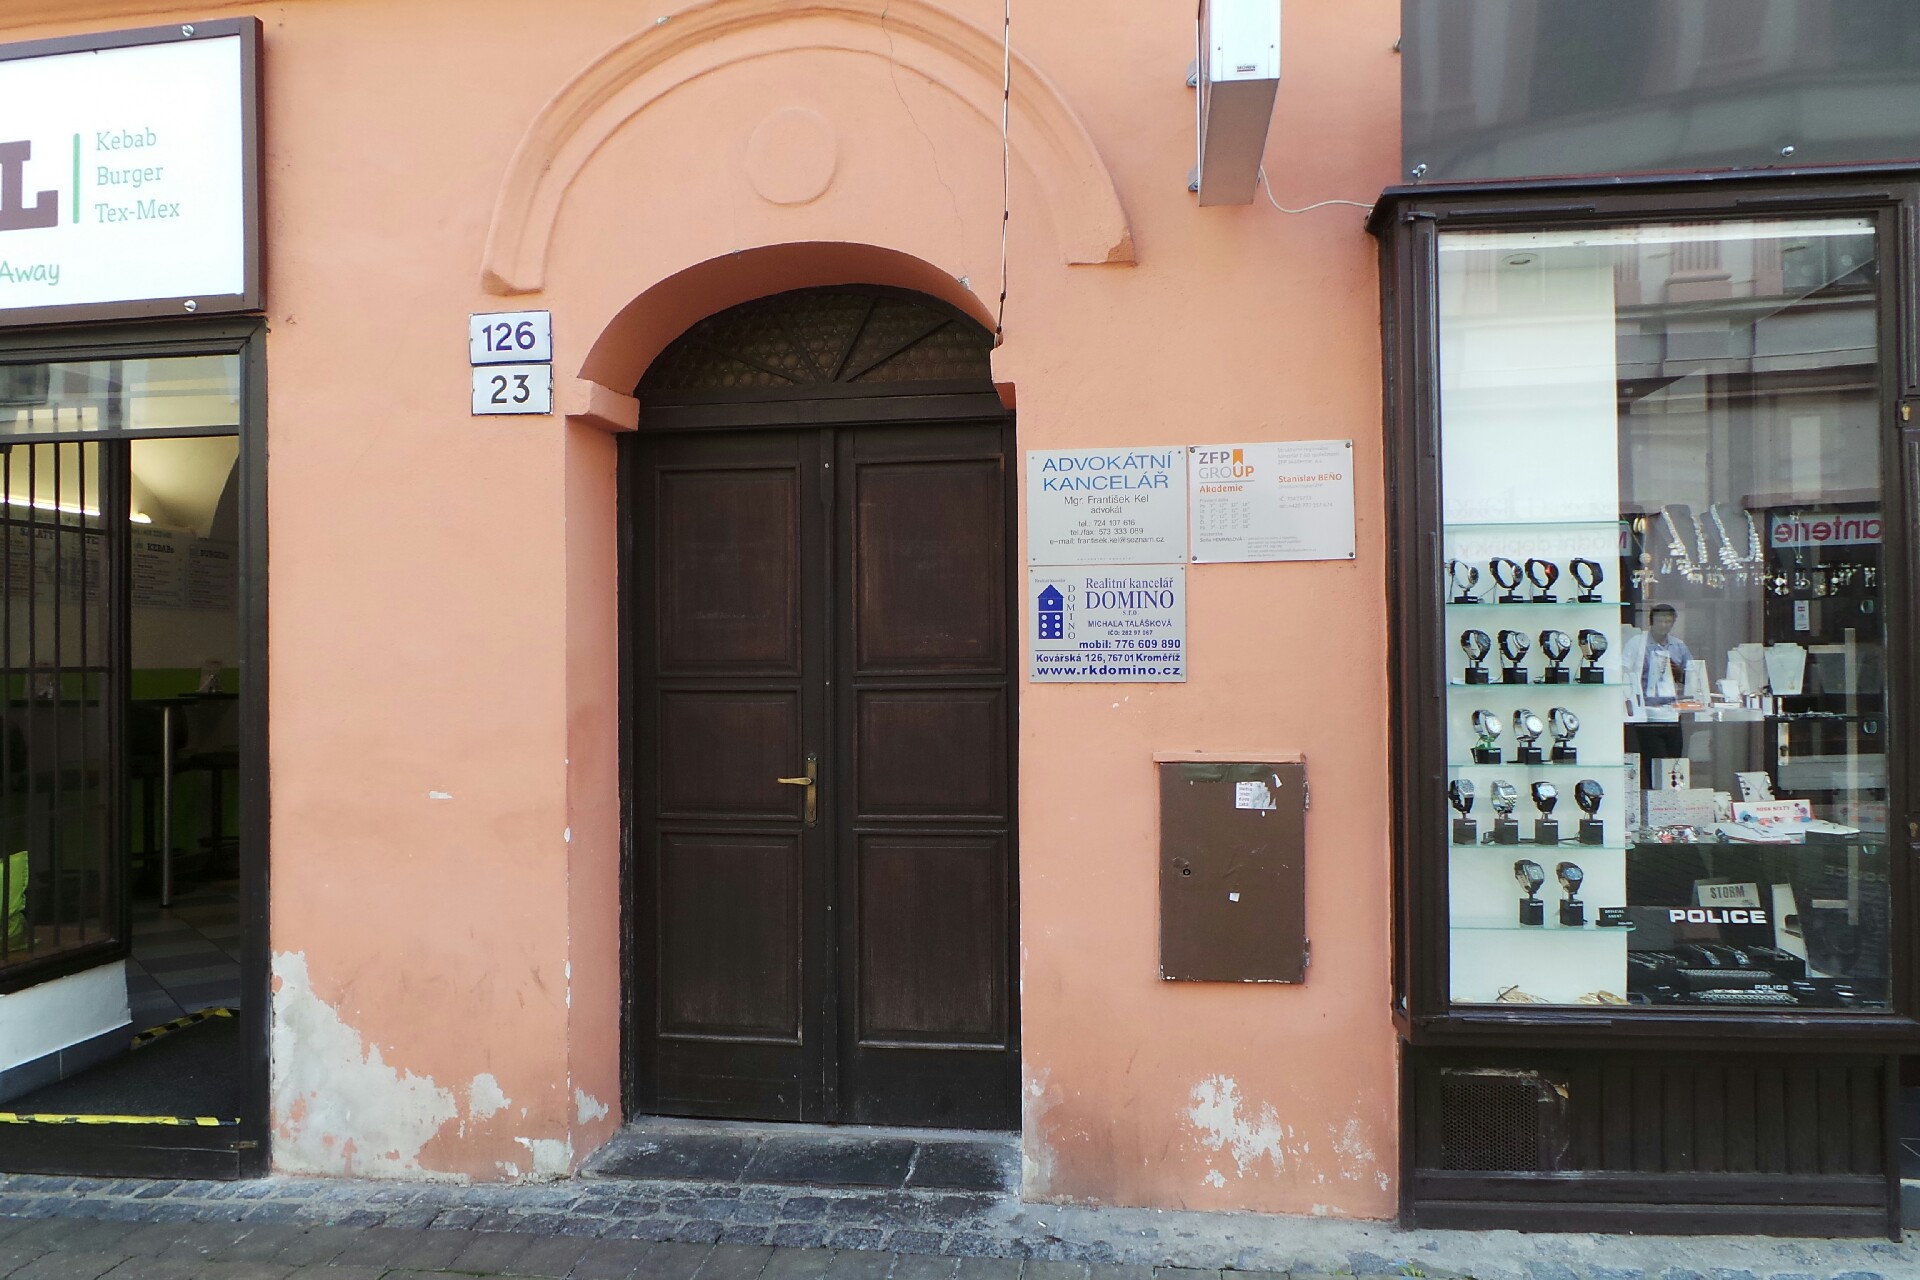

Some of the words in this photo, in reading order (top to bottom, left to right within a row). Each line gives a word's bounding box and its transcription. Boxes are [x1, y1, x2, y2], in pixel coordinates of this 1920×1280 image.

[96, 127, 157, 151] Kebab
[96, 166, 164, 188] Burger
[95, 199, 181, 223] Tex-Mex
[0, 260, 60, 286] Away
[482, 321, 536, 352] 126
[491, 375, 530, 404] 23
[1042, 451, 1172, 472] ADVOKÁTNÍ
[1199, 451, 1230, 464] ZFP
[1199, 465, 1254, 479] GROUP
[1278, 475, 1316, 483] Stanislav
[1318, 471, 1342, 481] BEŇO
[1043, 471, 1169, 491] KANCELÁŘ
[1200, 484, 1243, 493] Akademie
[1064, 496, 1083, 507] Mgr.
[1088, 495, 1130, 504] František
[1135, 494, 1149, 503] Kel
[1090, 506, 1122, 514] advokát
[1094, 519, 1106, 527] 724
[1098, 528, 1111, 536] 573
[1086, 577, 1126, 589] Realitní
[1129, 577, 1174, 588] kancelář
[1085, 590, 1174, 609] DOMINO
[1088, 620, 1124, 628] MICHALA
[1125, 618, 1172, 628] TALÁŠKOVÁ
[1079, 640, 1112, 649] mobil:
[1115, 640, 1135, 649] 776
[1138, 640, 1158, 649] 609
[1161, 639, 1181, 649] 890
[1036, 653, 1082, 663] Kovářská
[1085, 654, 1106, 664] 126,
[1135, 653, 1181, 663] Kroměříž
[1037, 665, 1181, 676] www.rkdomino.cz
[1710, 885, 1745, 899] STORM
[1669, 910, 1767, 924] POLICE
